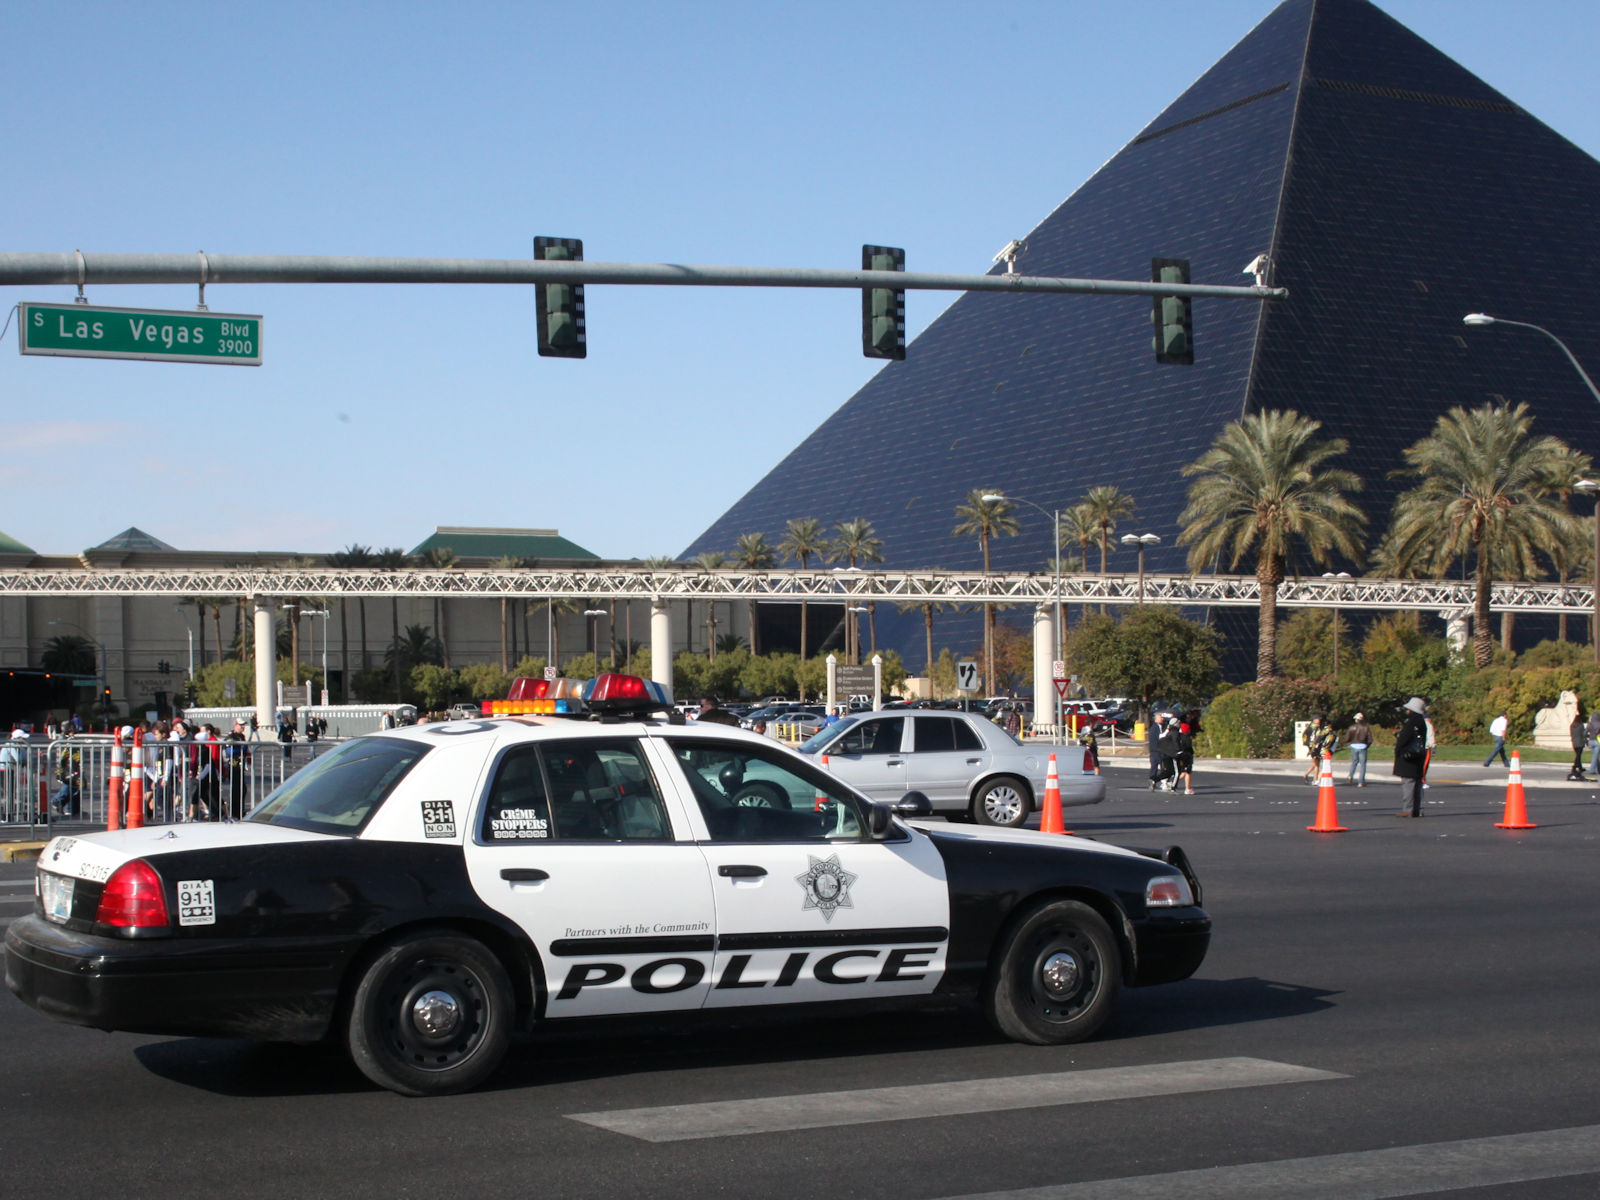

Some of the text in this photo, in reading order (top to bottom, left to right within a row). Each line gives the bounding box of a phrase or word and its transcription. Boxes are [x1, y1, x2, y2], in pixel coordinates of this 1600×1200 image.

[34, 312, 249, 349] S Las Vegas Blvd
[218, 339, 252, 354] 3900
[500, 808, 536, 820] CRIME
[491, 819, 547, 830] STOPPERS
[806, 862, 848, 885] METROPOLITAN
[181, 891, 212, 906] 9-1-1
[816, 899, 841, 909] POLICE
[565, 921, 711, 937] Partners with the Community
[554, 947, 939, 1001] POLICE
